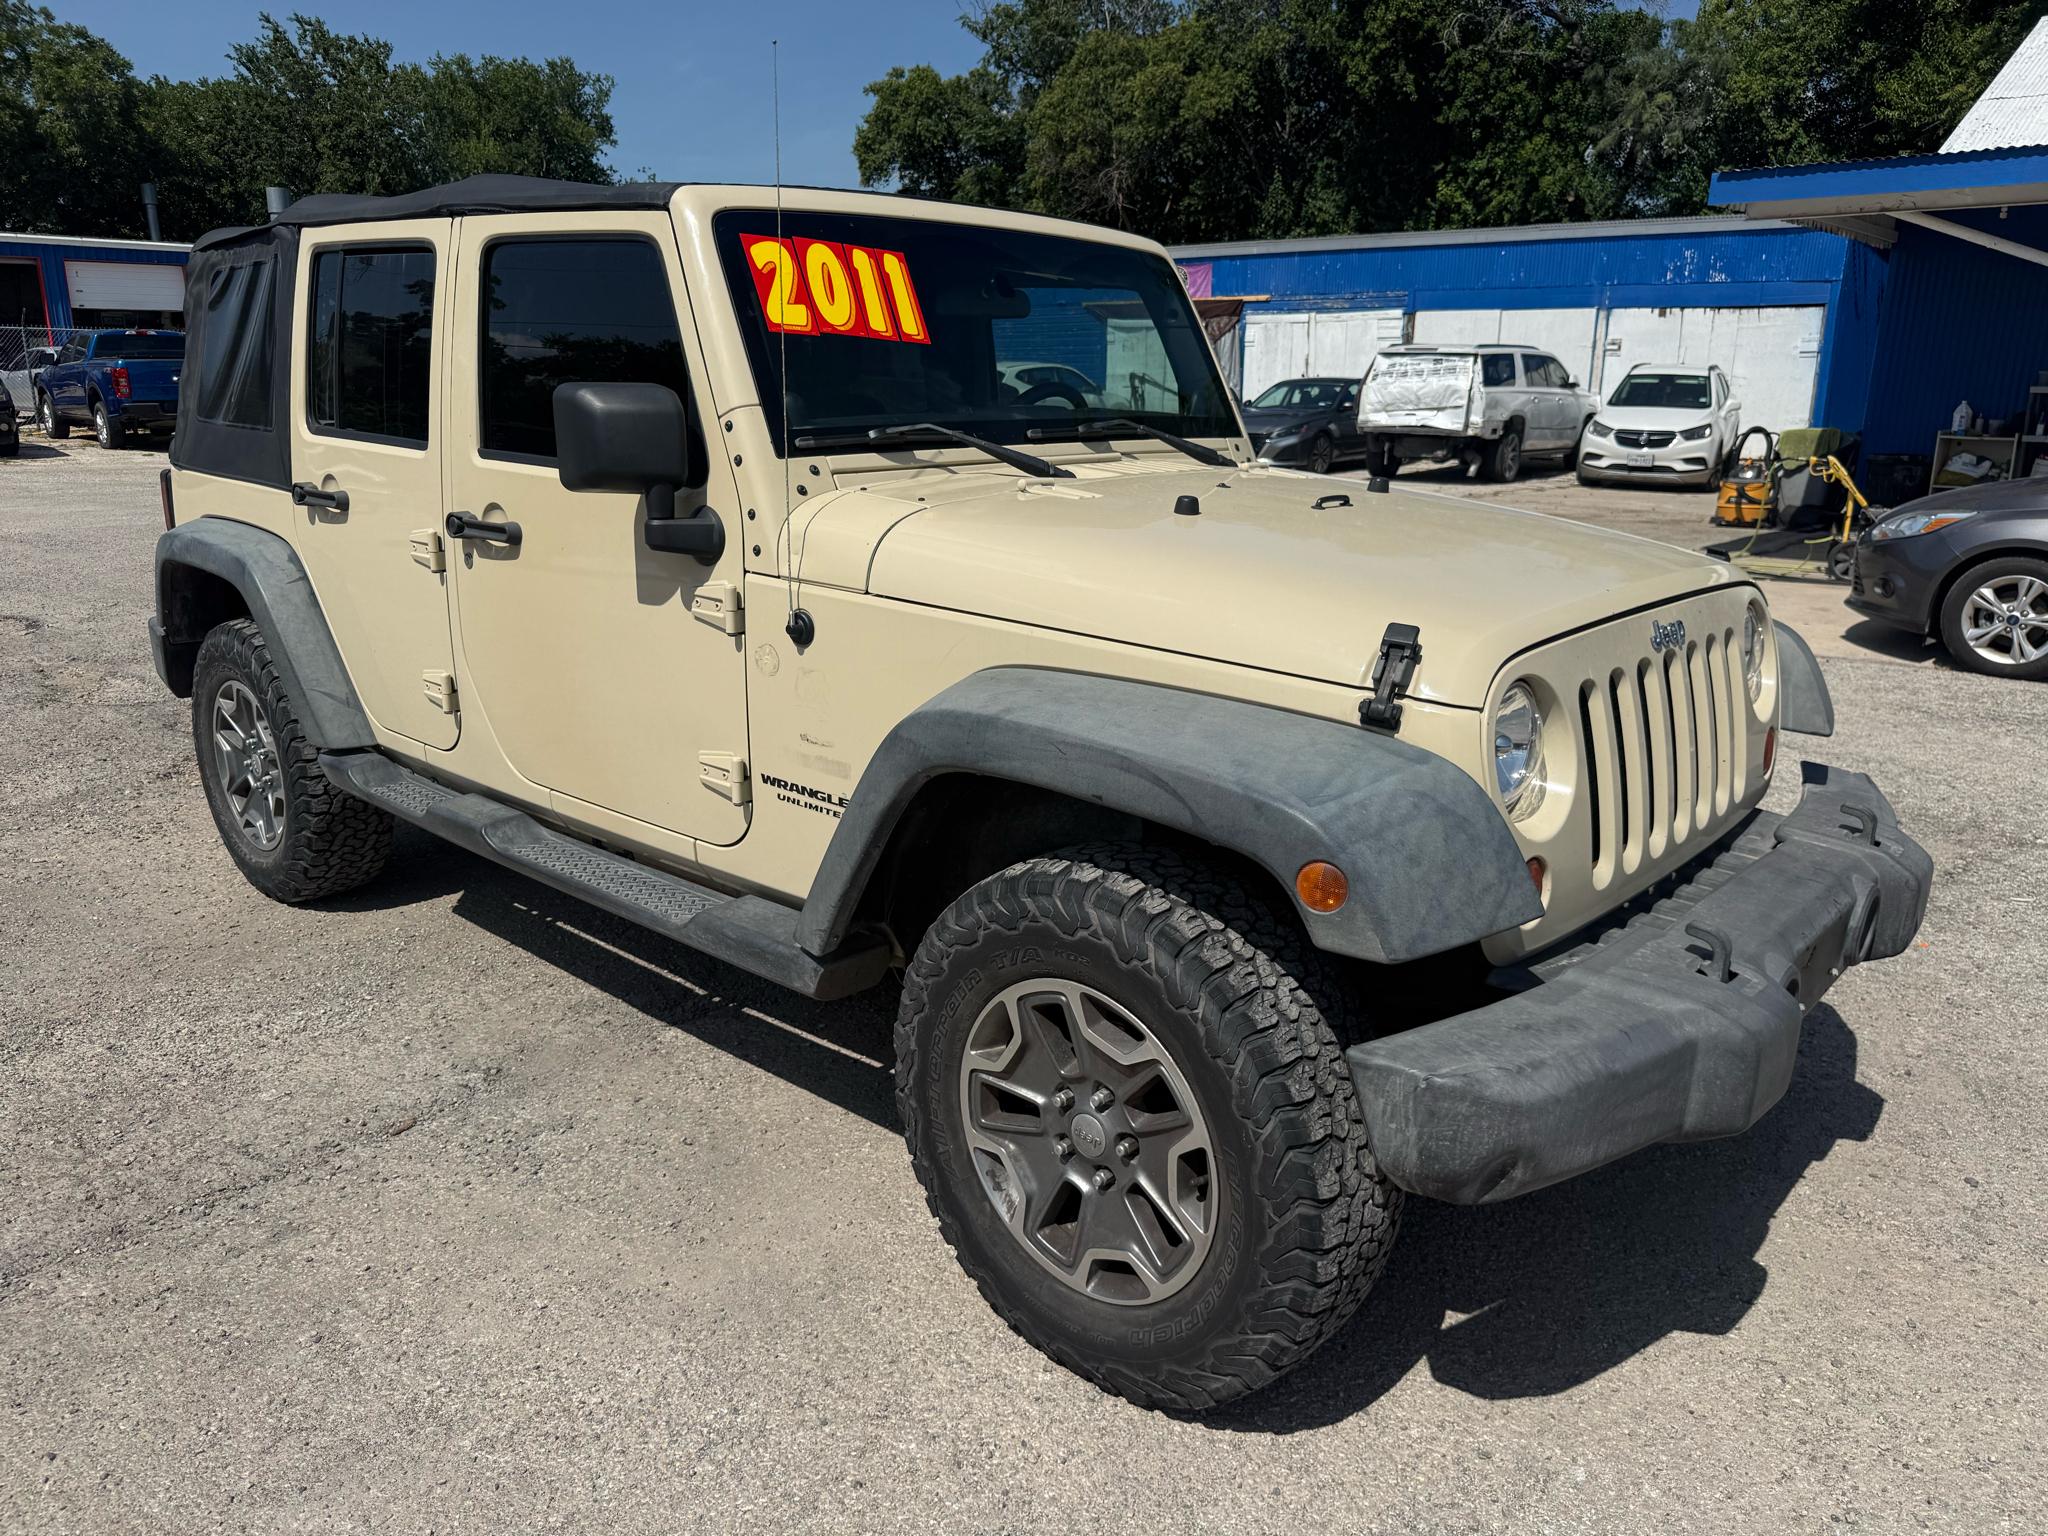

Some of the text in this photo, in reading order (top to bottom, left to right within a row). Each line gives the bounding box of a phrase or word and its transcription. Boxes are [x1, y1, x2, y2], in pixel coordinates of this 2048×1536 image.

[749, 240, 925, 340] 2011
[1650, 619, 1686, 653] Jeep
[760, 773, 850, 808] WRANGLE
[777, 793, 842, 818] UNLIMITE
[990, 946, 1045, 970] T/A
[1074, 1127, 1102, 1150] Jeep
